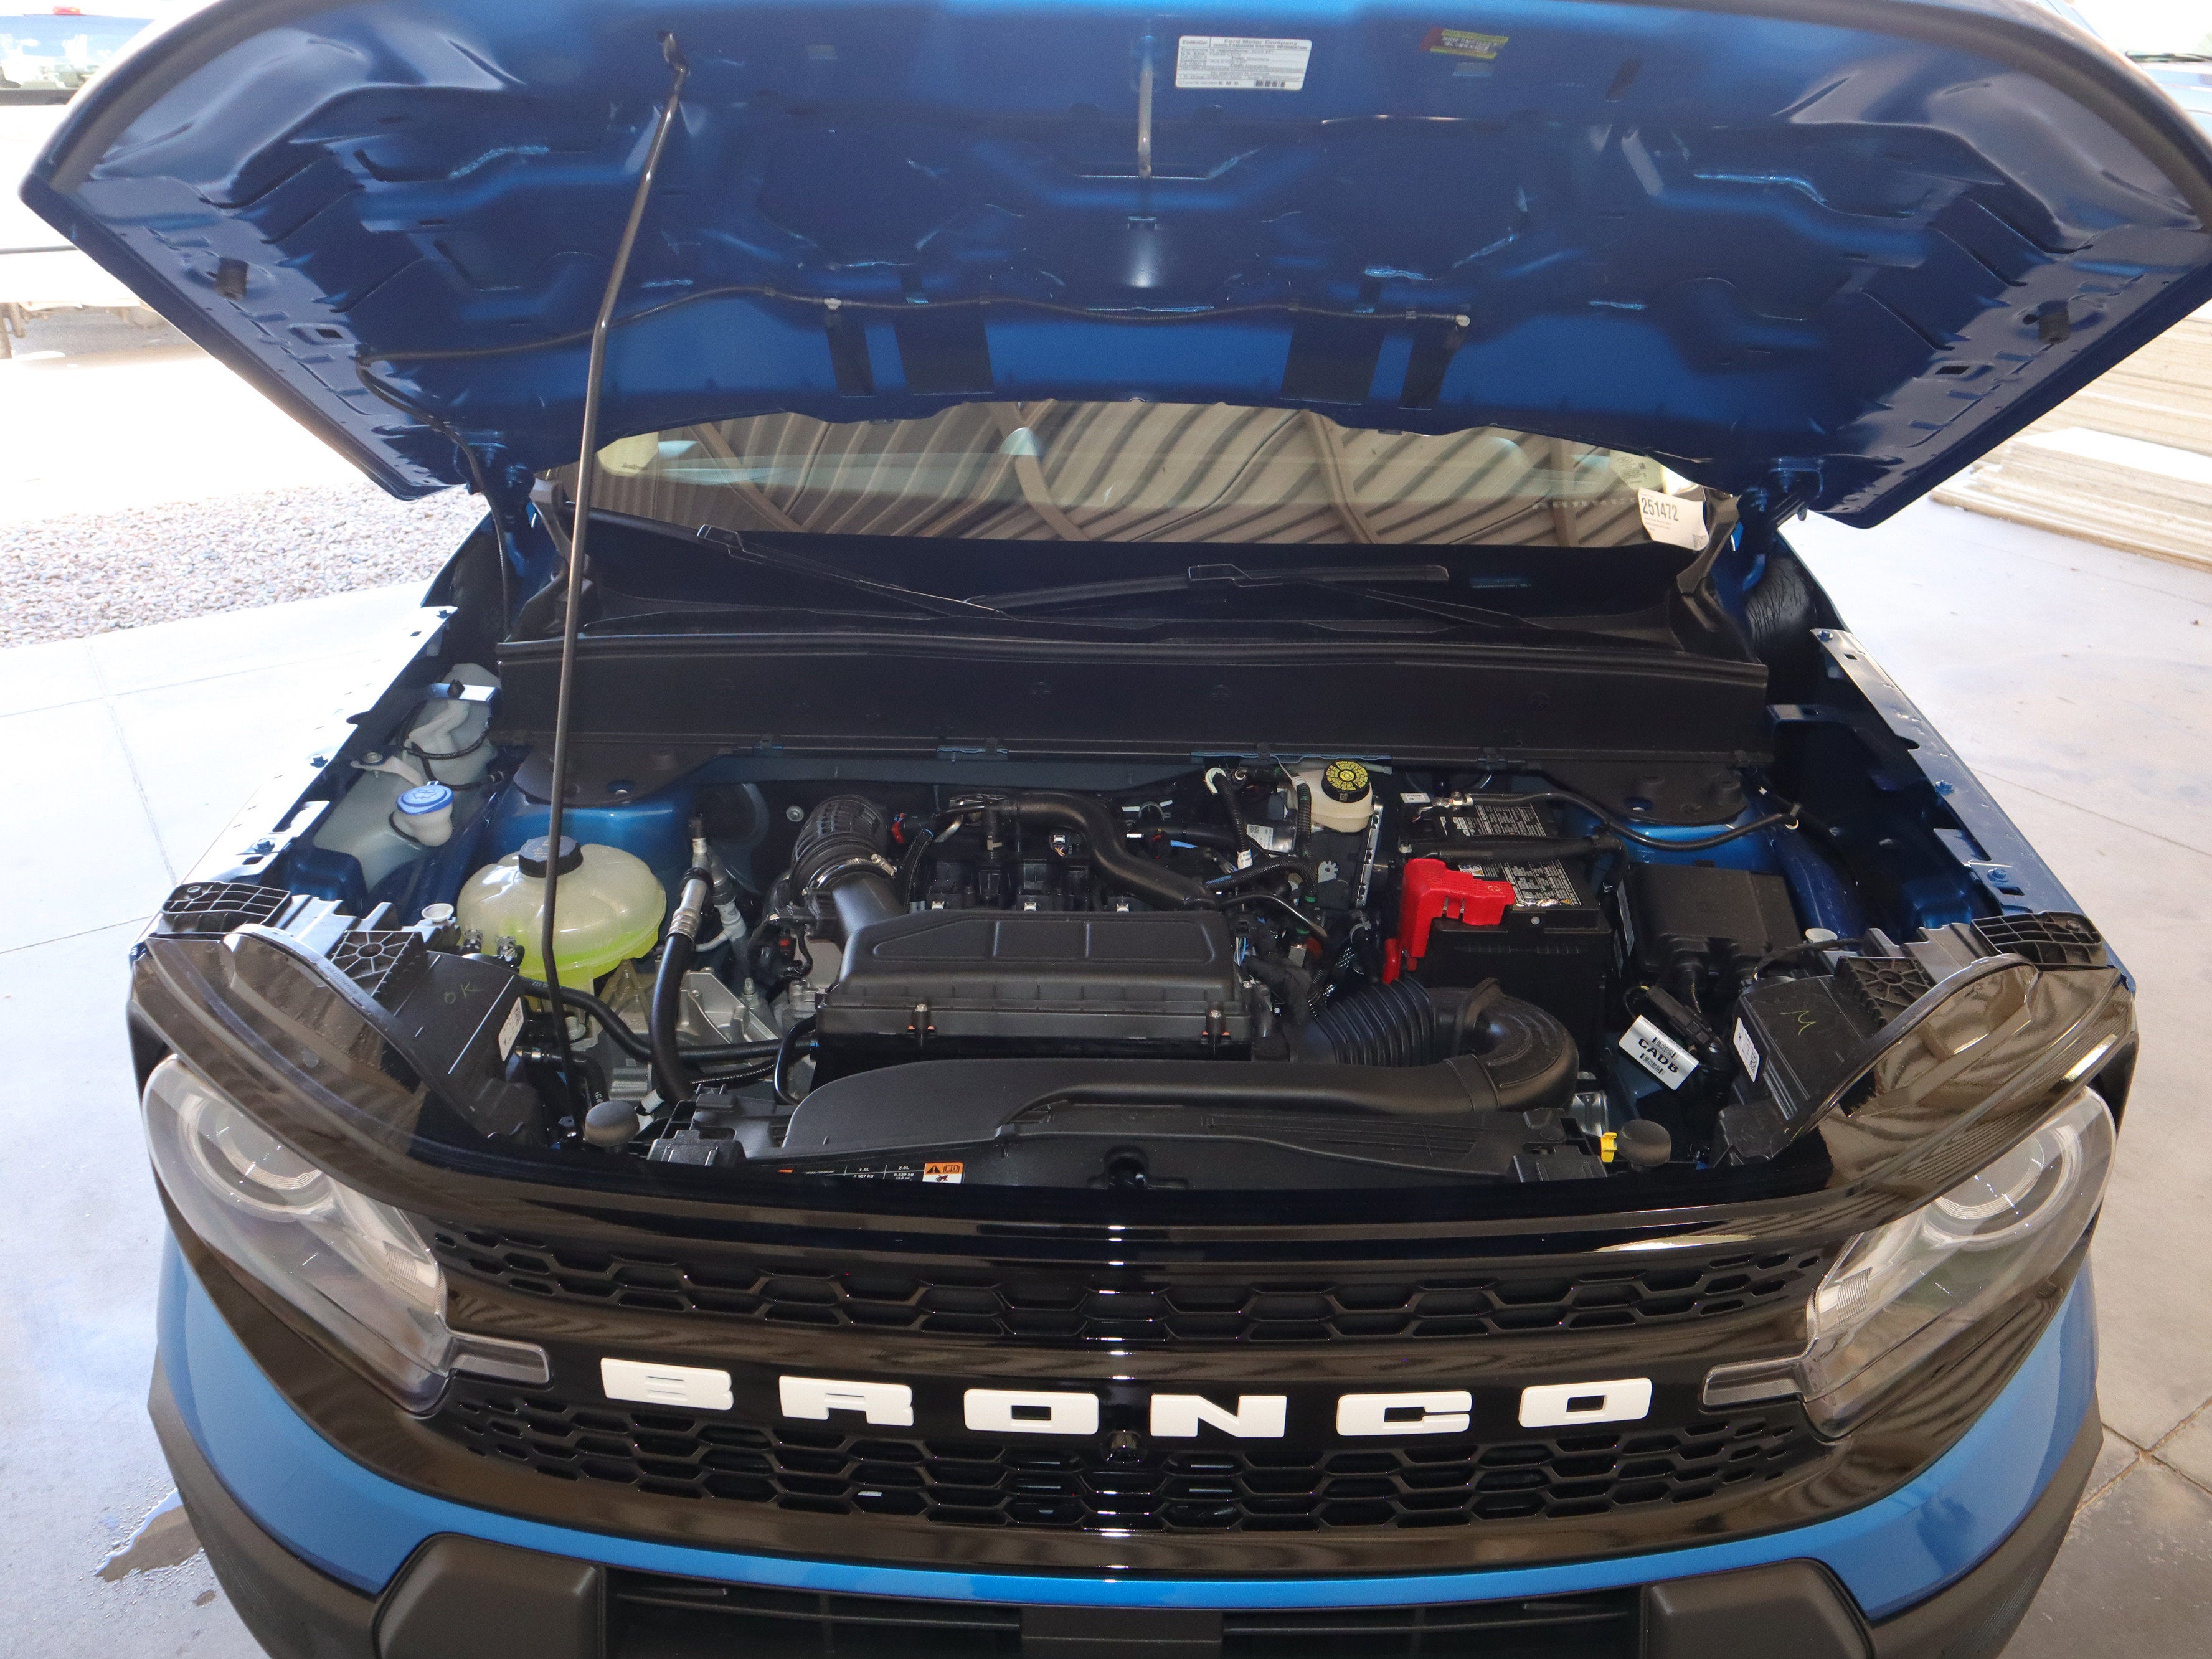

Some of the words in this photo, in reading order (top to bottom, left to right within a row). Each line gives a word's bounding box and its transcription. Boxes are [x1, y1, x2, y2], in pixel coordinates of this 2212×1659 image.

[1641, 497, 1680, 522] 251472
[1638, 1038, 1679, 1073] CADB
[600, 1357, 1653, 1439] BRONCO
